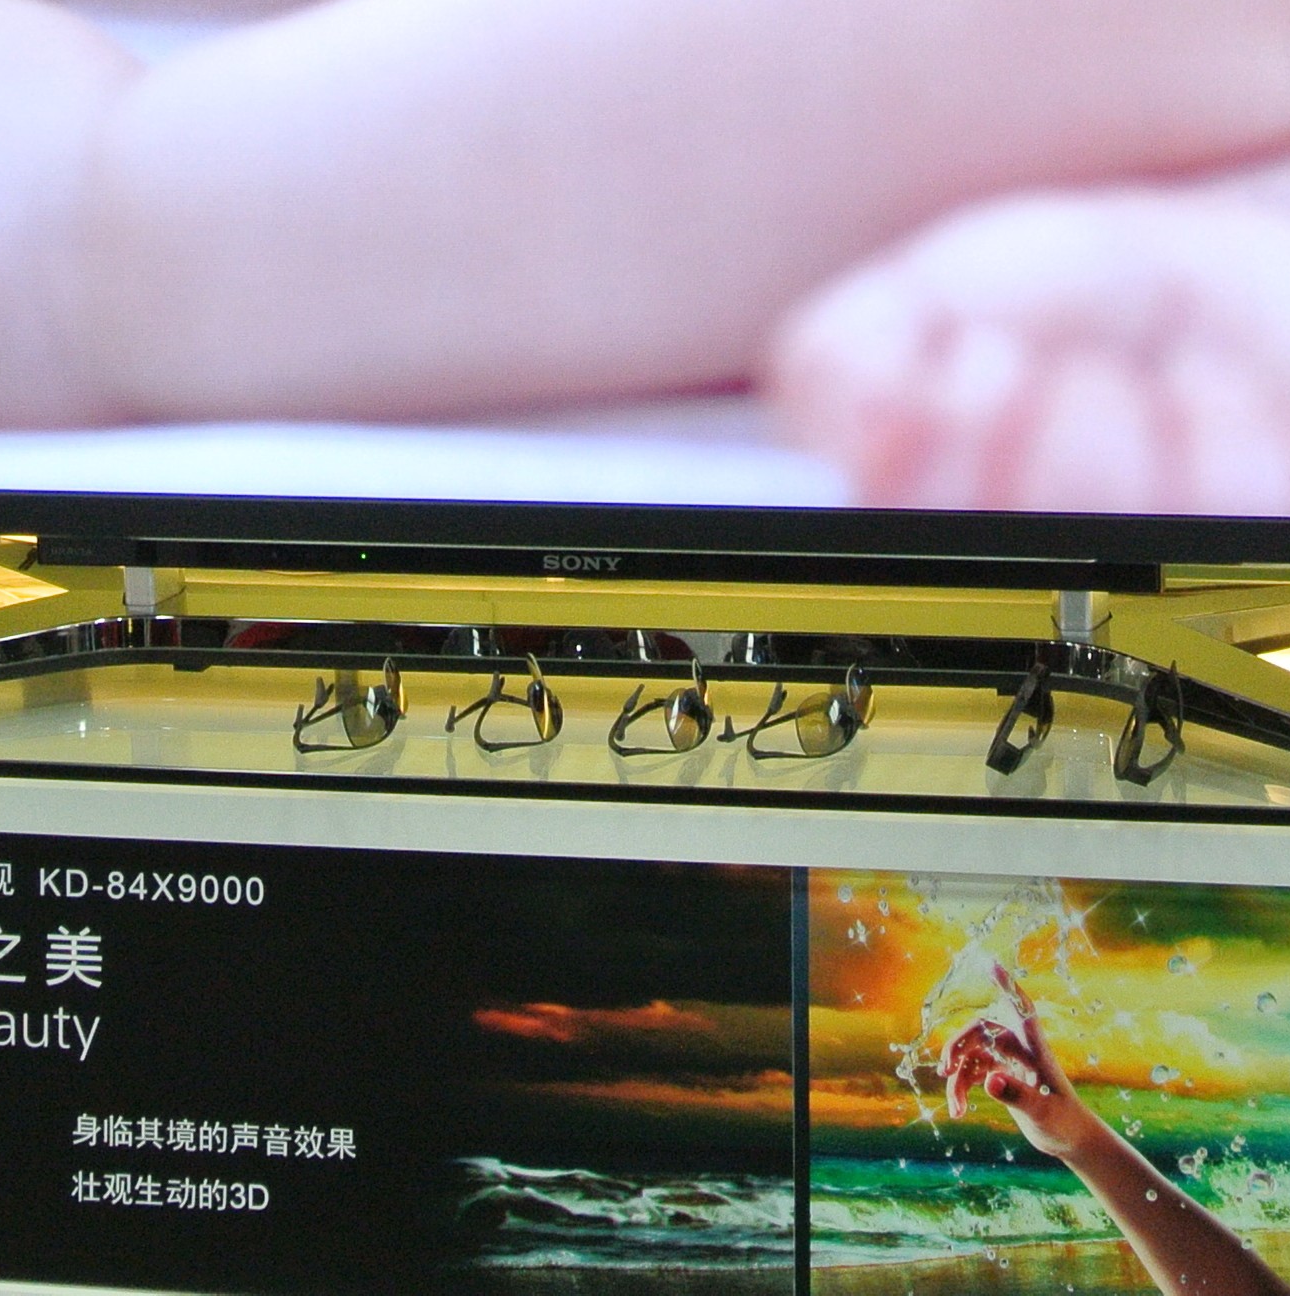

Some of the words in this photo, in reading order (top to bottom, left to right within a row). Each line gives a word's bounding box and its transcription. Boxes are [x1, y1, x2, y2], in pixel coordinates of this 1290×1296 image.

[543, 554, 622, 571] SONY
[38, 867, 265, 906] KD-84X9000
[71, 1112, 358, 1161] 身临其境的声音效果
[70, 1169, 270, 1212] 壮观生动的3D
